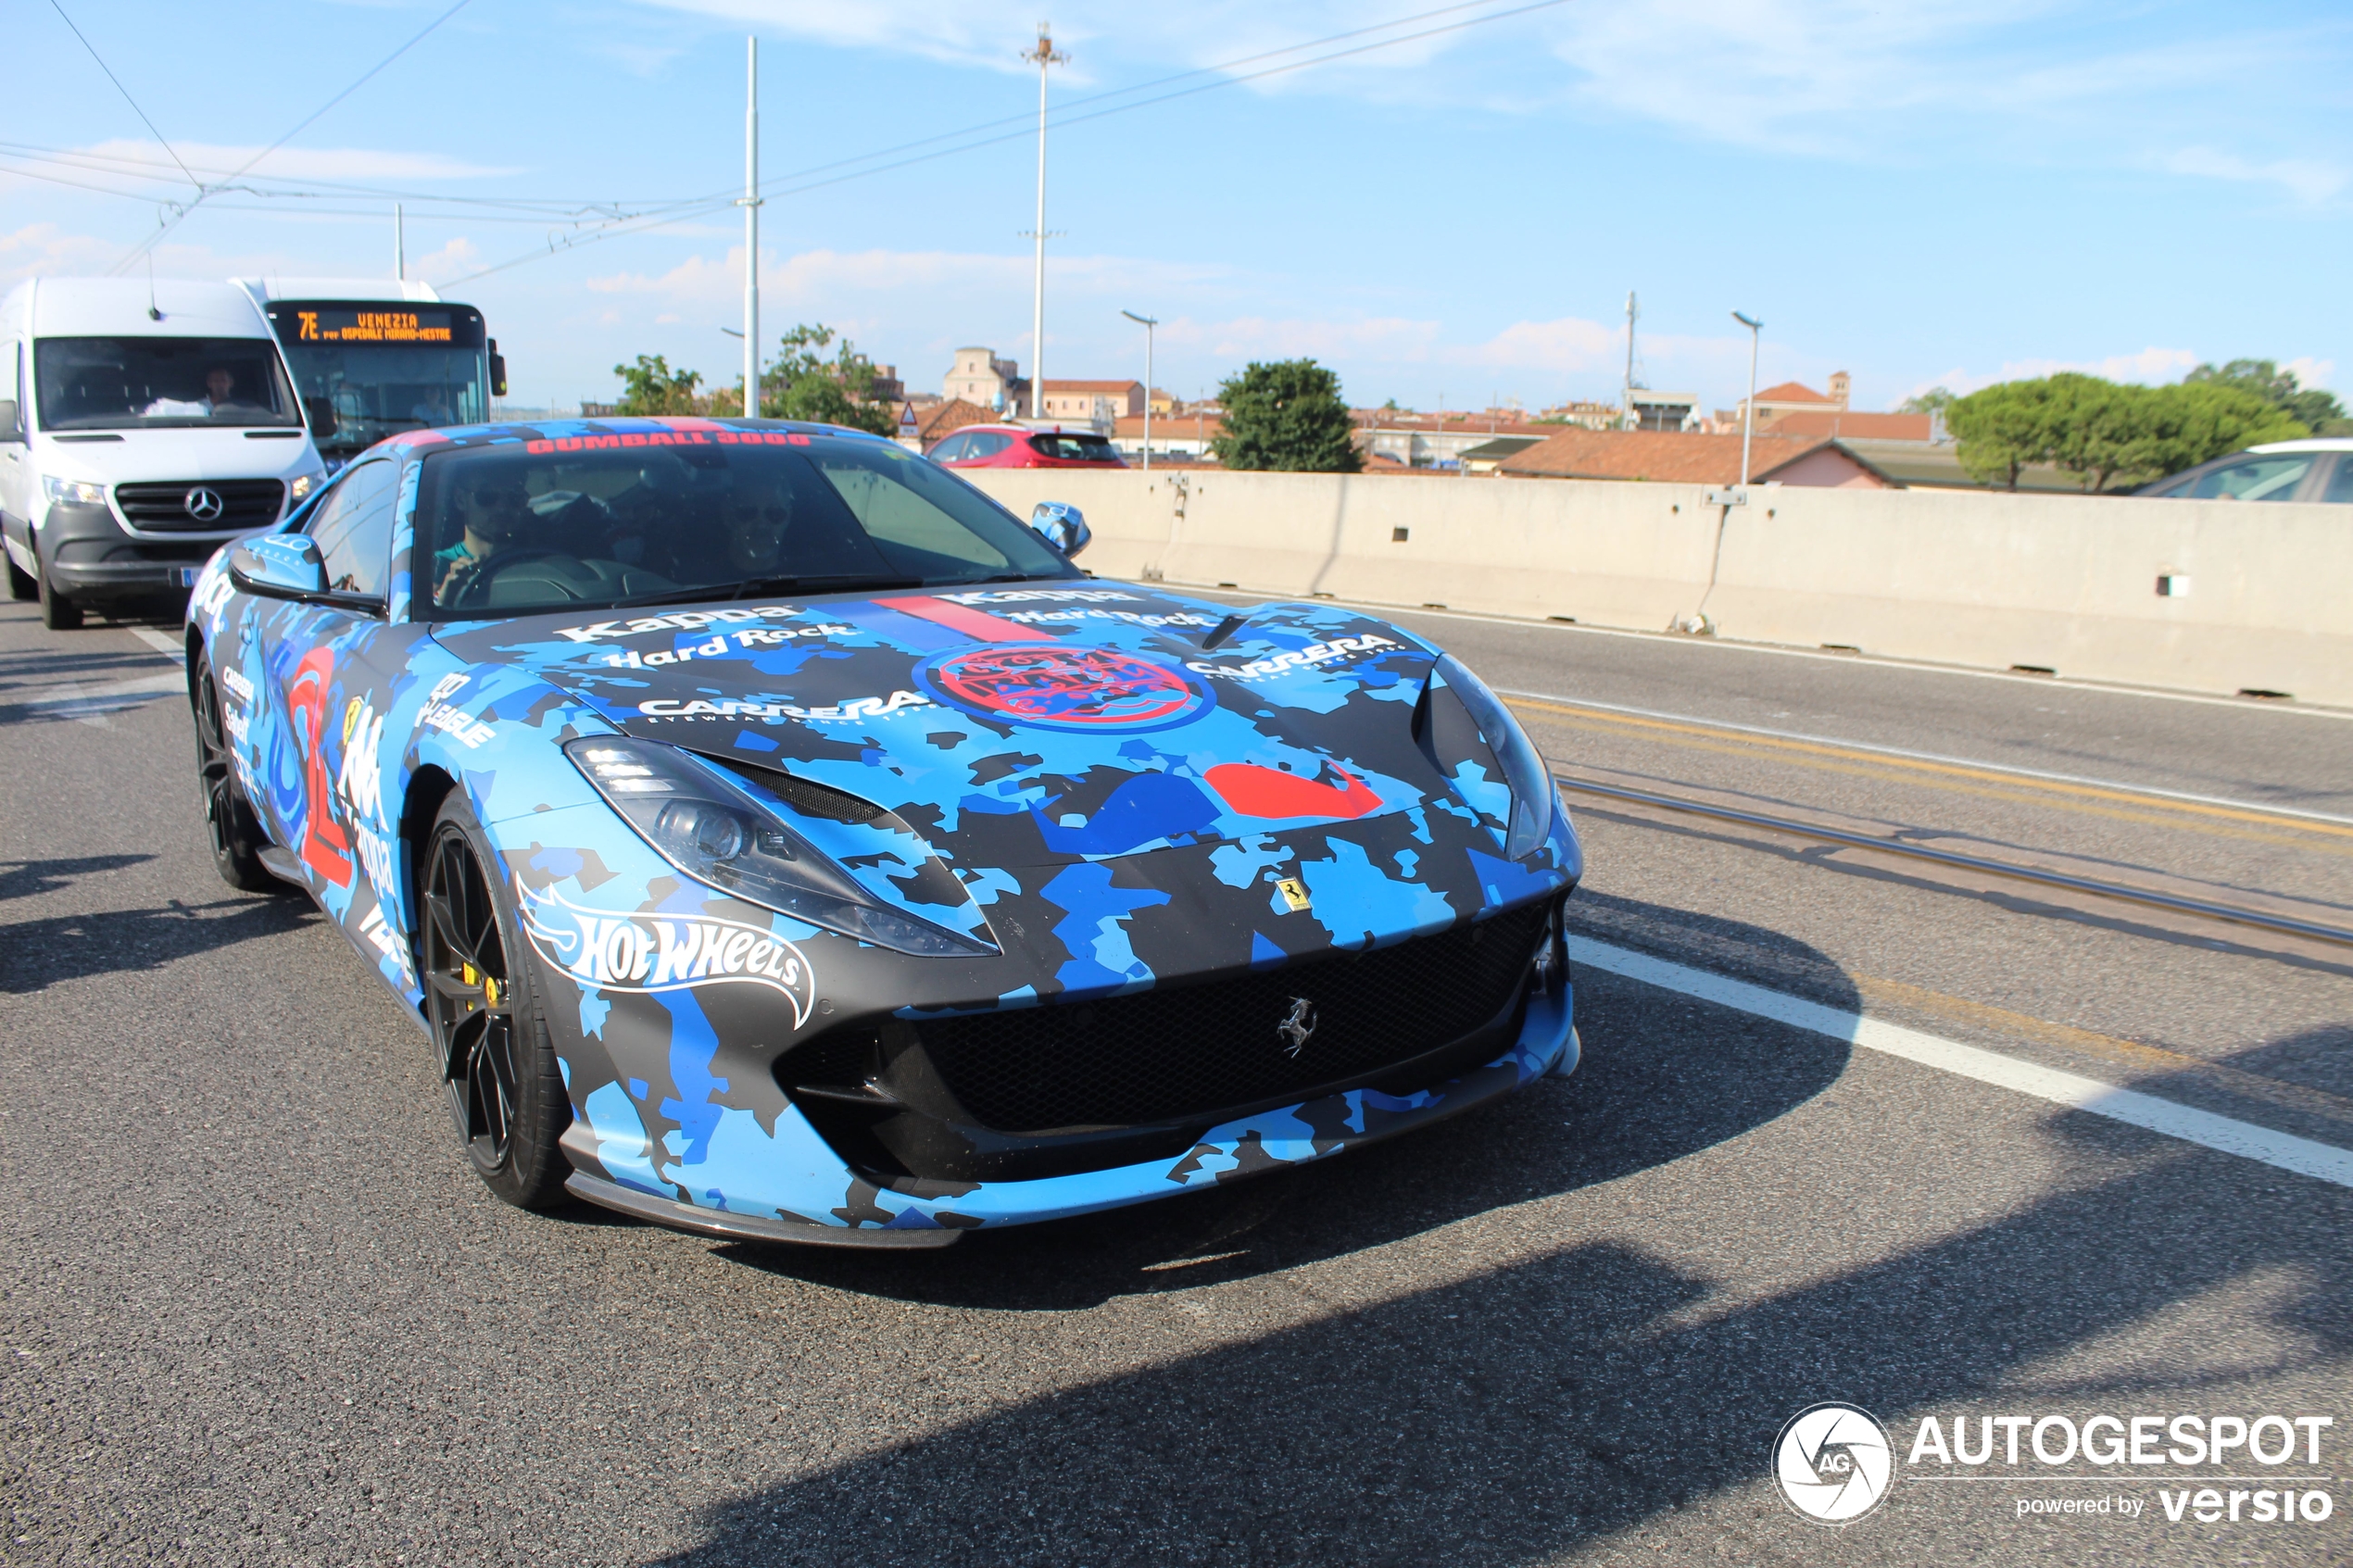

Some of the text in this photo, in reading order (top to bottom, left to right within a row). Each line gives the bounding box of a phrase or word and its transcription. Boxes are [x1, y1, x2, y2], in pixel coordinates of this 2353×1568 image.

[297, 311, 418, 340] 7E VENEZIA
[341, 328, 383, 340] OSPEDALE
[384, 328, 451, 341] MIRANO-MESTRE
[526, 431, 811, 455] GUMBALL 3000
[932, 590, 1146, 605] Kappa
[553, 605, 799, 643] Kappa
[1008, 608, 1218, 627] Hard Rock
[601, 621, 858, 669] Hard Rock
[1186, 633, 1396, 678] CARRERA
[1303, 654, 1356, 671] SINCE
[639, 690, 929, 721] CARRERA
[648, 704, 937, 726] EYEWEAR SINCE 1956
